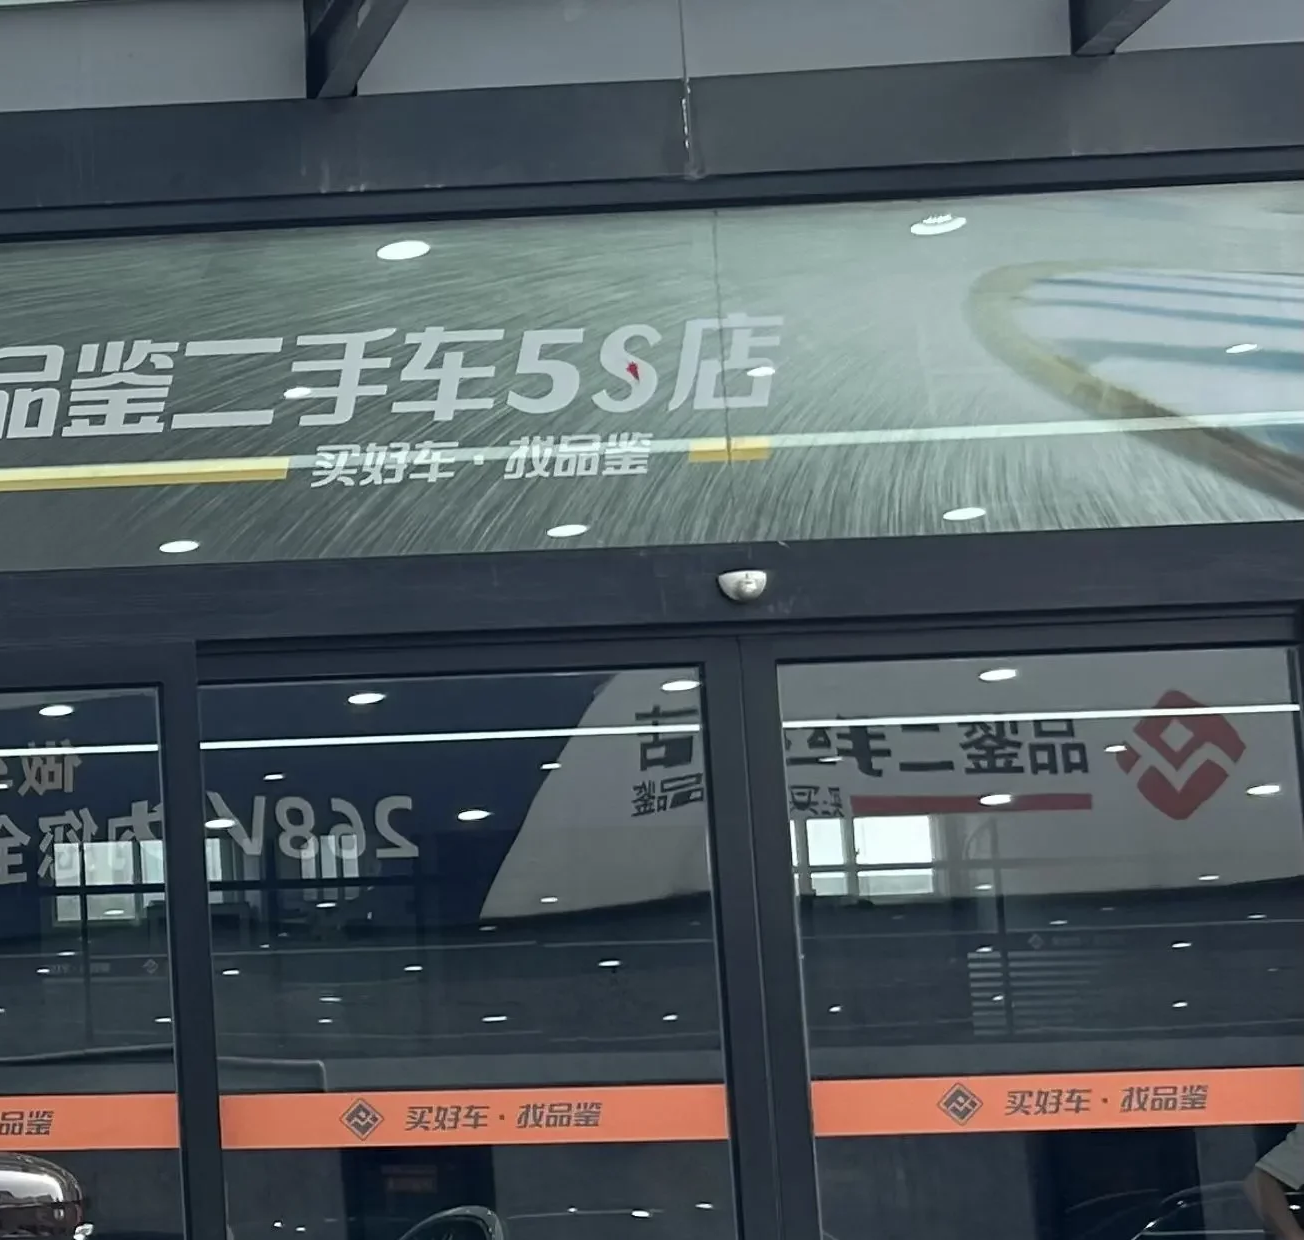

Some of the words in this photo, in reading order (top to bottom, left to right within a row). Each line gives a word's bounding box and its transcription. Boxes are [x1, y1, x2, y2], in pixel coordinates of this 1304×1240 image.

[309, 432, 653, 488] 买好车·找品鉴
[1004, 1085, 1208, 1116] 买好车·找品鉴
[404, 1102, 602, 1131] 买好车·找品鉴
